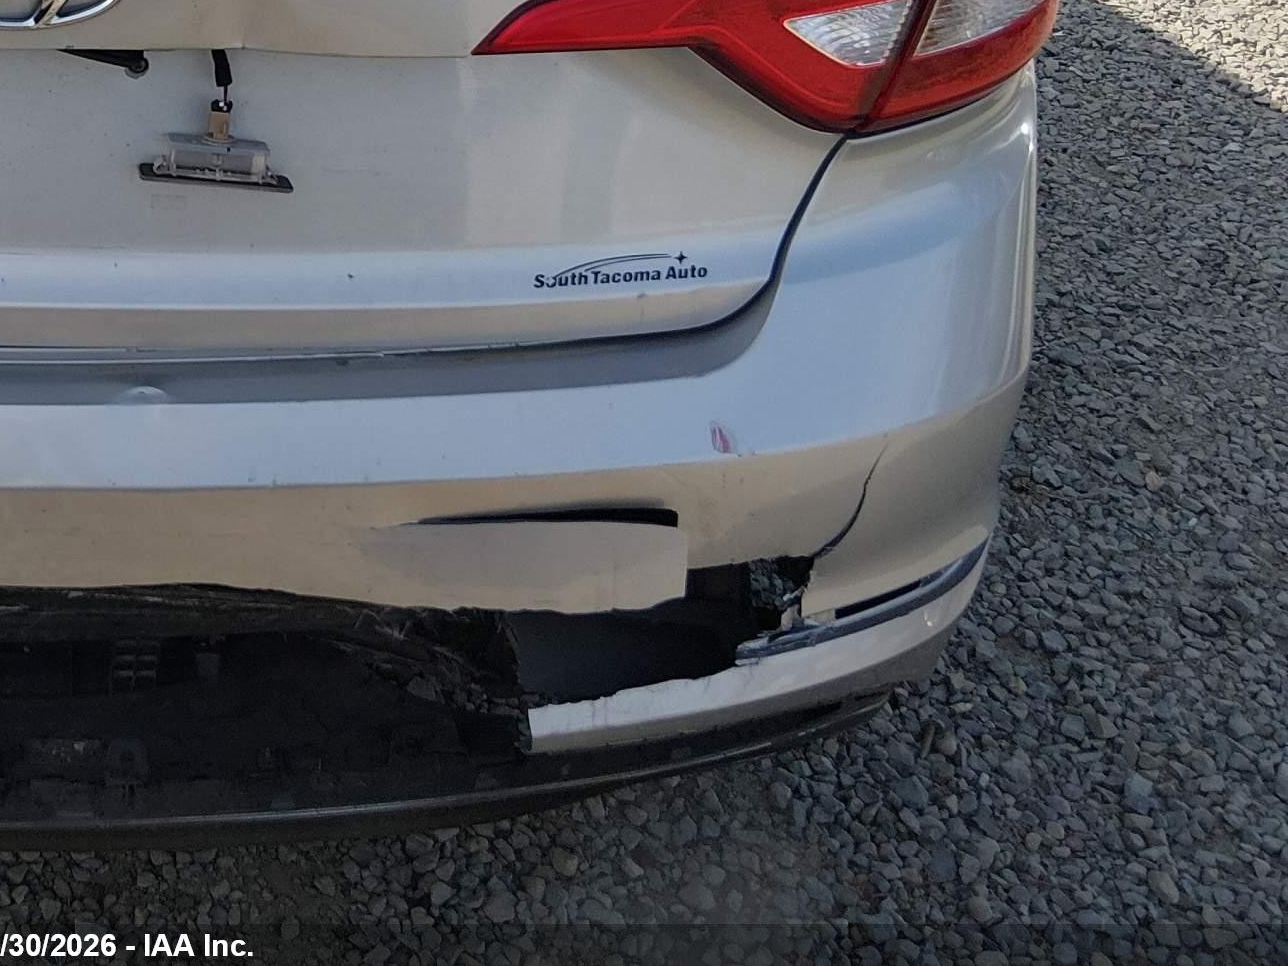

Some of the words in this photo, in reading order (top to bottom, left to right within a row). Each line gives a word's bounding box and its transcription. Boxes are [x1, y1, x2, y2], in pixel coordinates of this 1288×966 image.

[534, 270, 588, 288] South
[591, 269, 661, 284] Tacoma
[665, 265, 708, 279] Auto
